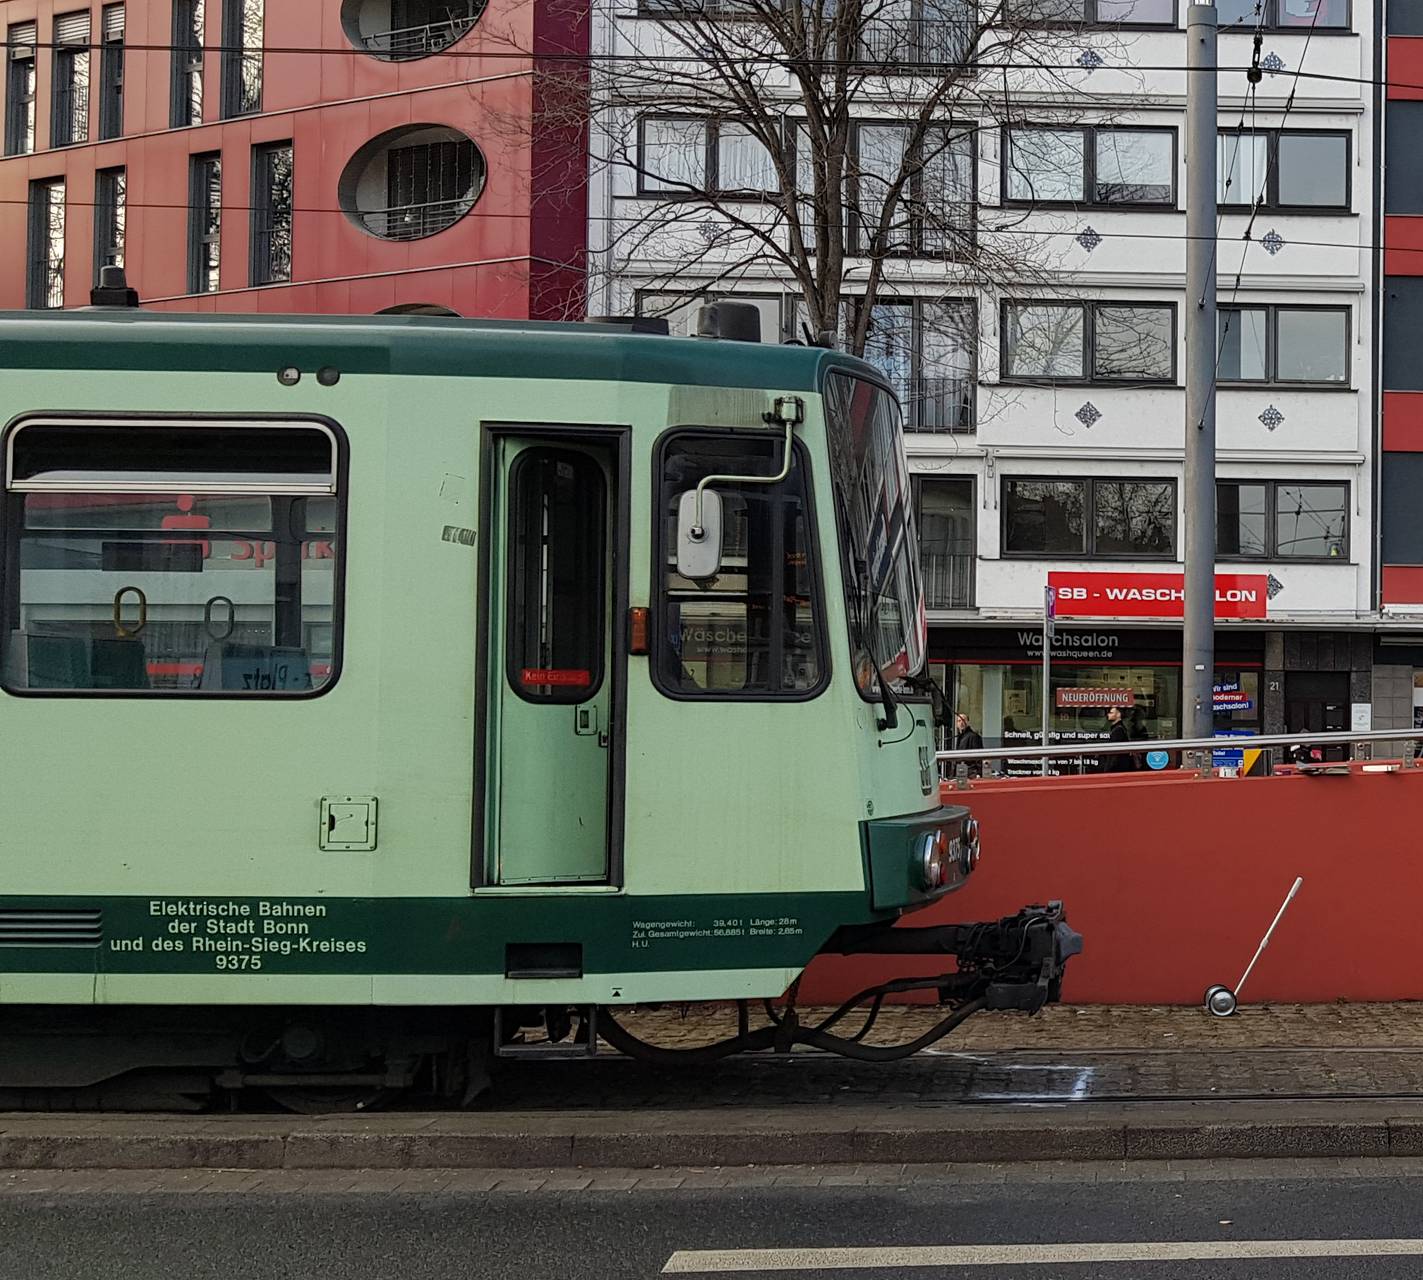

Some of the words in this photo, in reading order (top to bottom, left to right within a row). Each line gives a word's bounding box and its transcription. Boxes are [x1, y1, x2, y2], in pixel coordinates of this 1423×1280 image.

[1058, 587, 1087, 600] SB
[1105, 587, 1257, 603] WASCHLON
[1017, 632, 1119, 647] Wachsalon
[1270, 682, 1280, 691] 21
[1062, 691, 1129, 702] NEUERÖFFNUNG
[1004, 731, 1033, 740] Schnell,
[1062, 731, 1077, 739] und
[1078, 732, 1098, 740] super
[1091, 759, 1099, 767] kg
[150, 901, 250, 917] Elektrische
[259, 902, 327, 917] Bahnen
[168, 919, 198, 934] der
[206, 919, 255, 934] Stadt
[263, 920, 309, 935] Bonn
[632, 920, 696, 930] Wagengewicht:
[110, 937, 143, 951] und
[152, 937, 184, 951] des
[192, 938, 367, 956] Rhein-Sieg-Kreises
[215, 955, 262, 970] 9375
